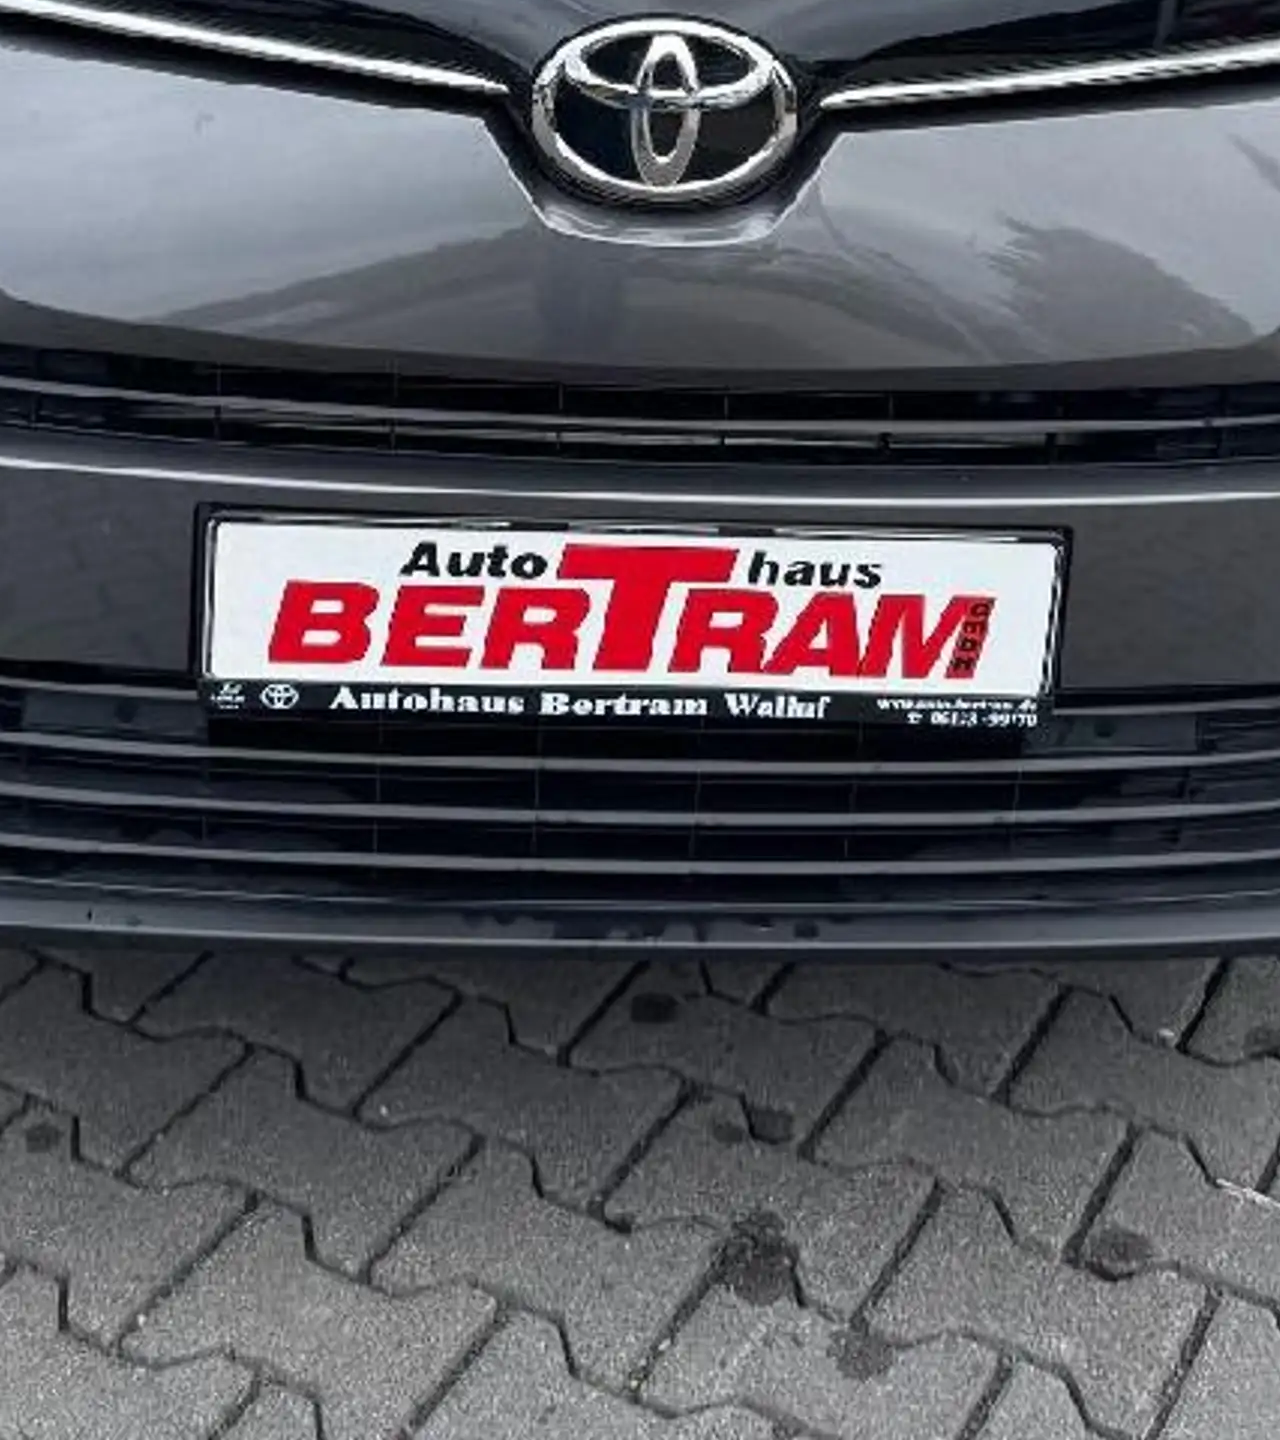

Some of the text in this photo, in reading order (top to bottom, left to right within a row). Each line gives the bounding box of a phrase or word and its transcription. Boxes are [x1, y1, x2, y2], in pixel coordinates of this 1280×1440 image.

[400, 541, 883, 589] Auto haus
[268, 543, 996, 679] BERTRAM
[329, 685, 524, 715] Autohaus
[537, 691, 708, 718] Bertram
